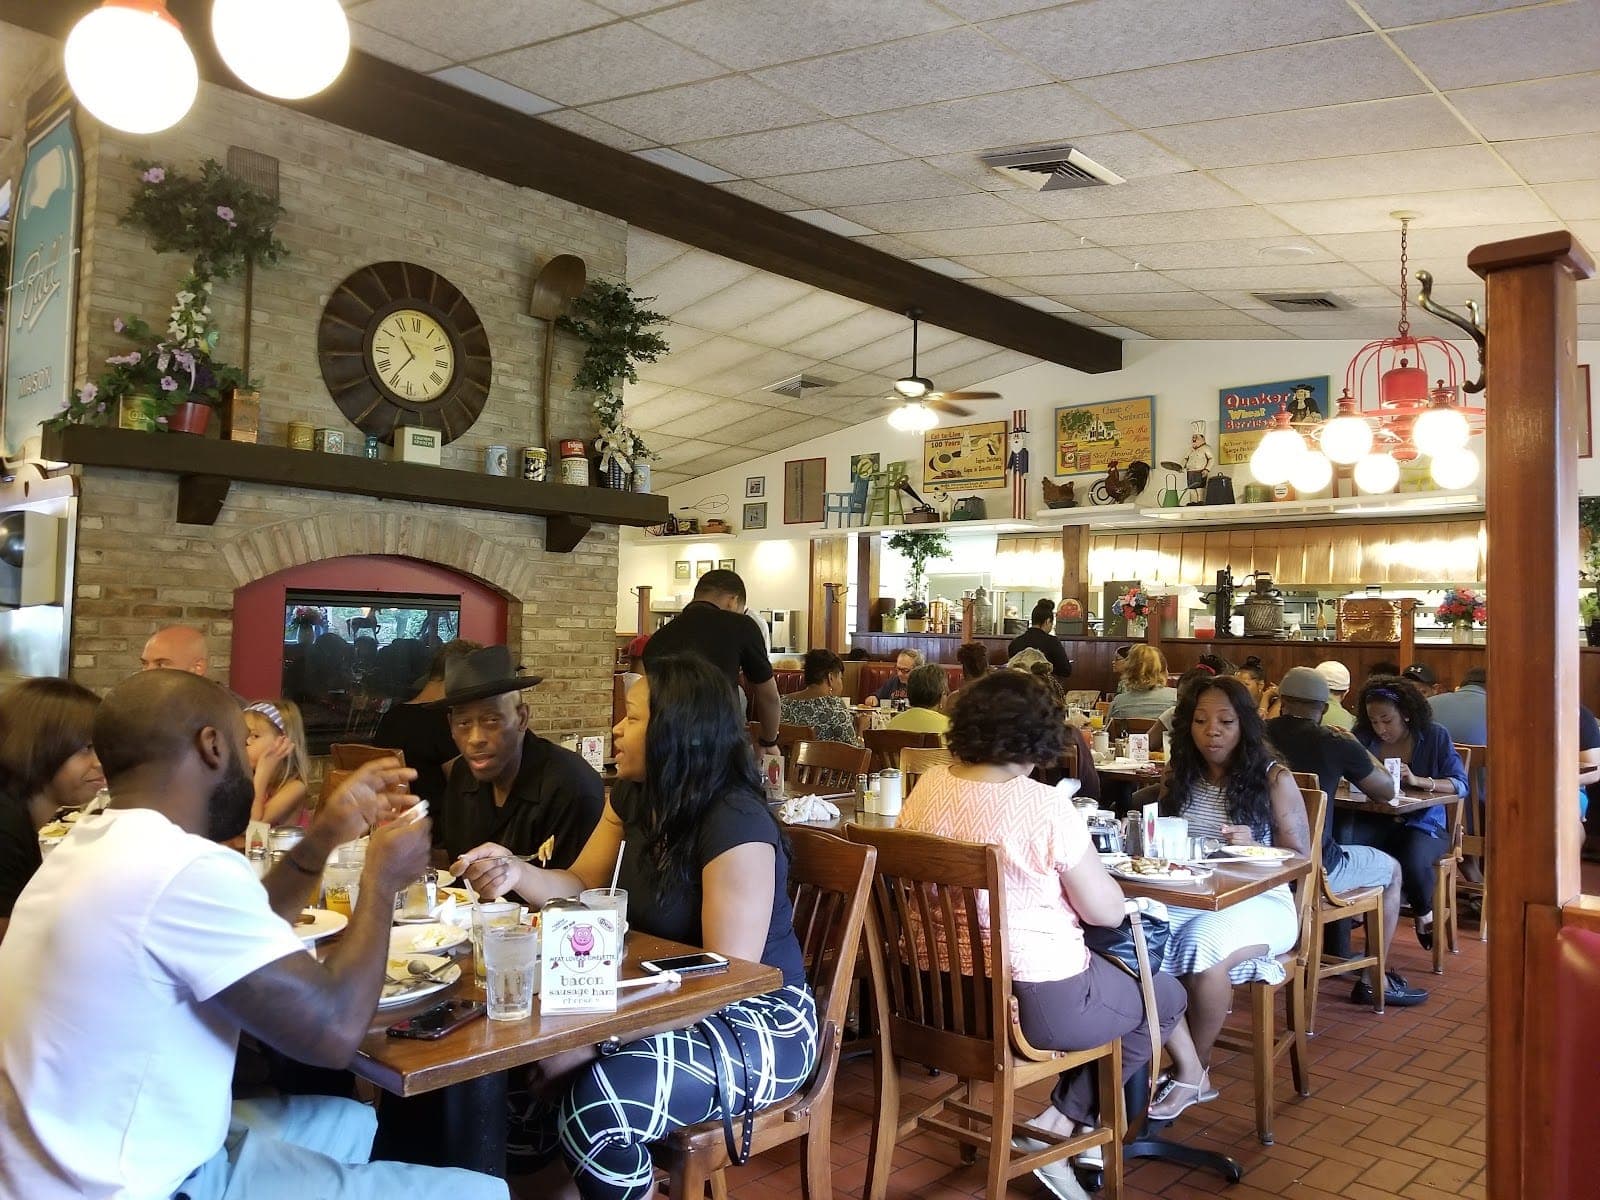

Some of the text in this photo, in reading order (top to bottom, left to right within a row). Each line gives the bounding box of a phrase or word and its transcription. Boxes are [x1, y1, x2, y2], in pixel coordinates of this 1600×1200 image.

[18, 366, 52, 399] MASON
[1224, 392, 1291, 409] Quaker
[931, 441, 943, 449] 100
[560, 975, 604, 987] bacon
[549, 988, 589, 998] sausage
